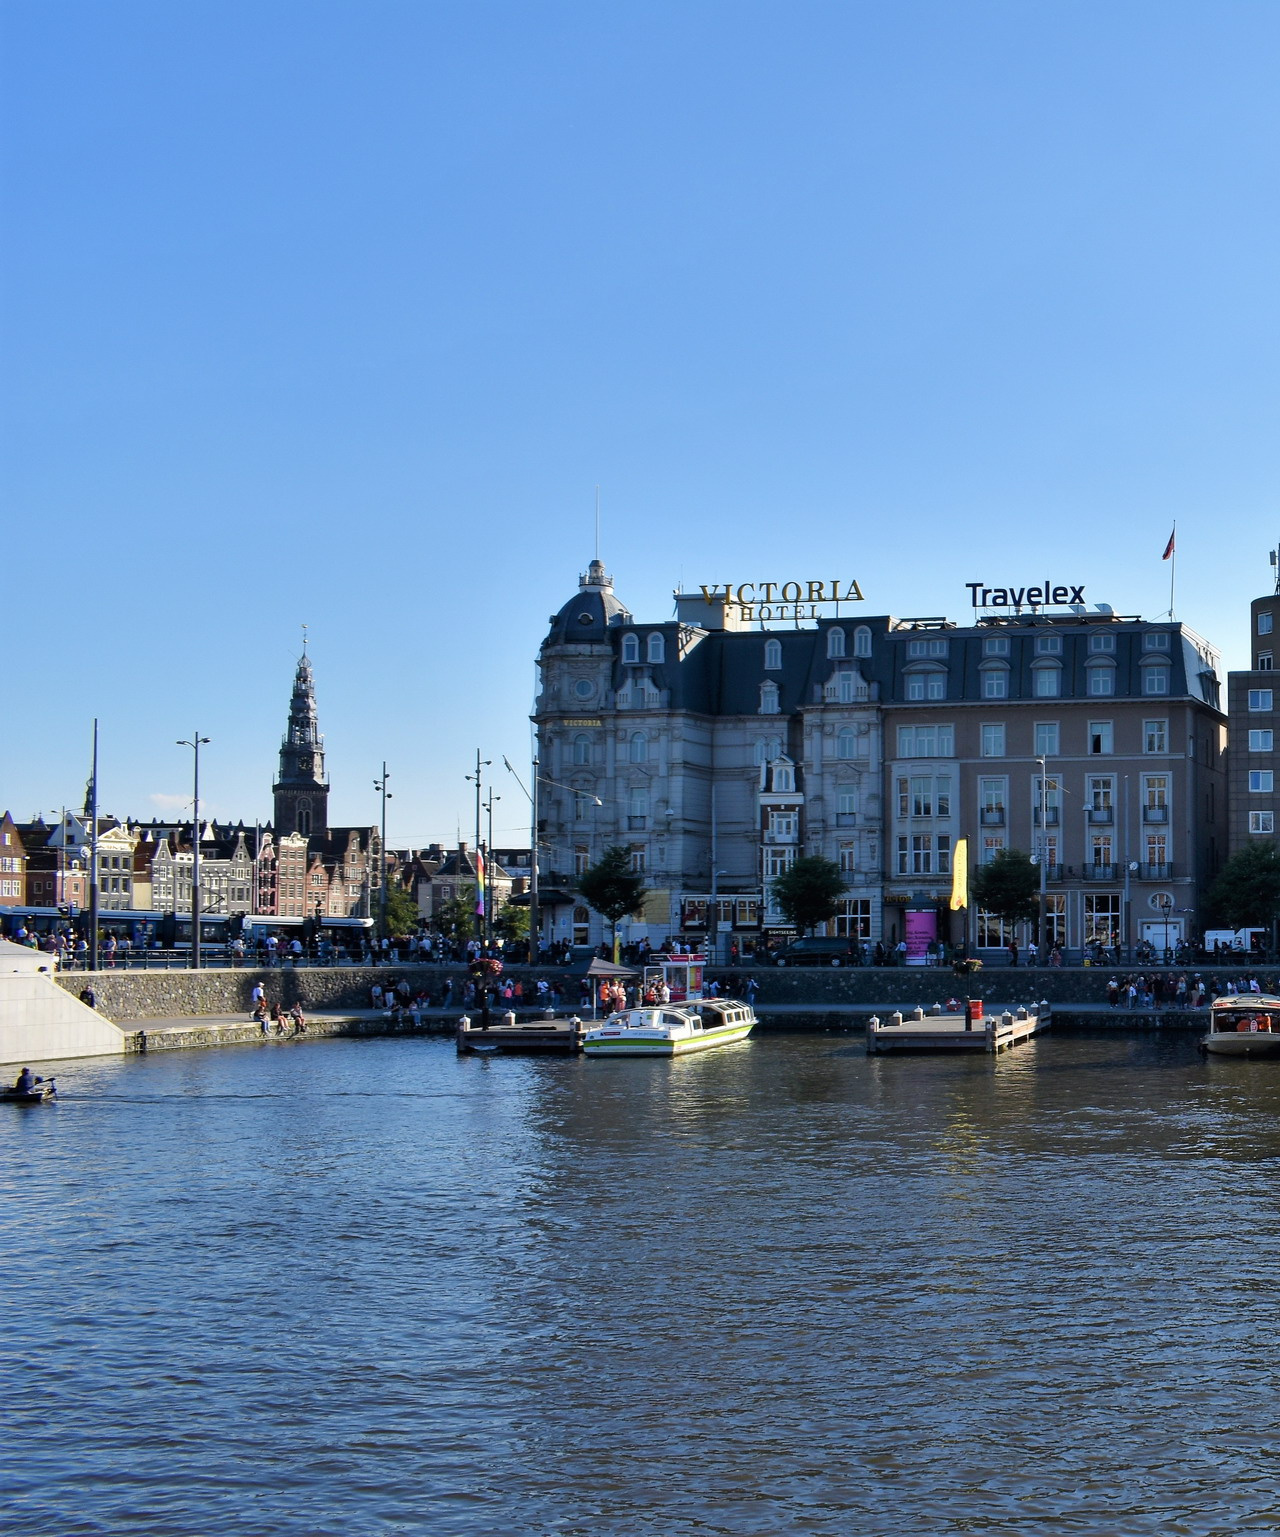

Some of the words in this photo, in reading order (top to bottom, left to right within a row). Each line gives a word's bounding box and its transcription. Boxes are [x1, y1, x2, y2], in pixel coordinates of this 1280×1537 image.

[699, 579, 865, 606] VICTORIA
[965, 580, 1086, 607] Travelex
[740, 604, 822, 622] HOTEL
[563, 719, 602, 727] VICTORIA
